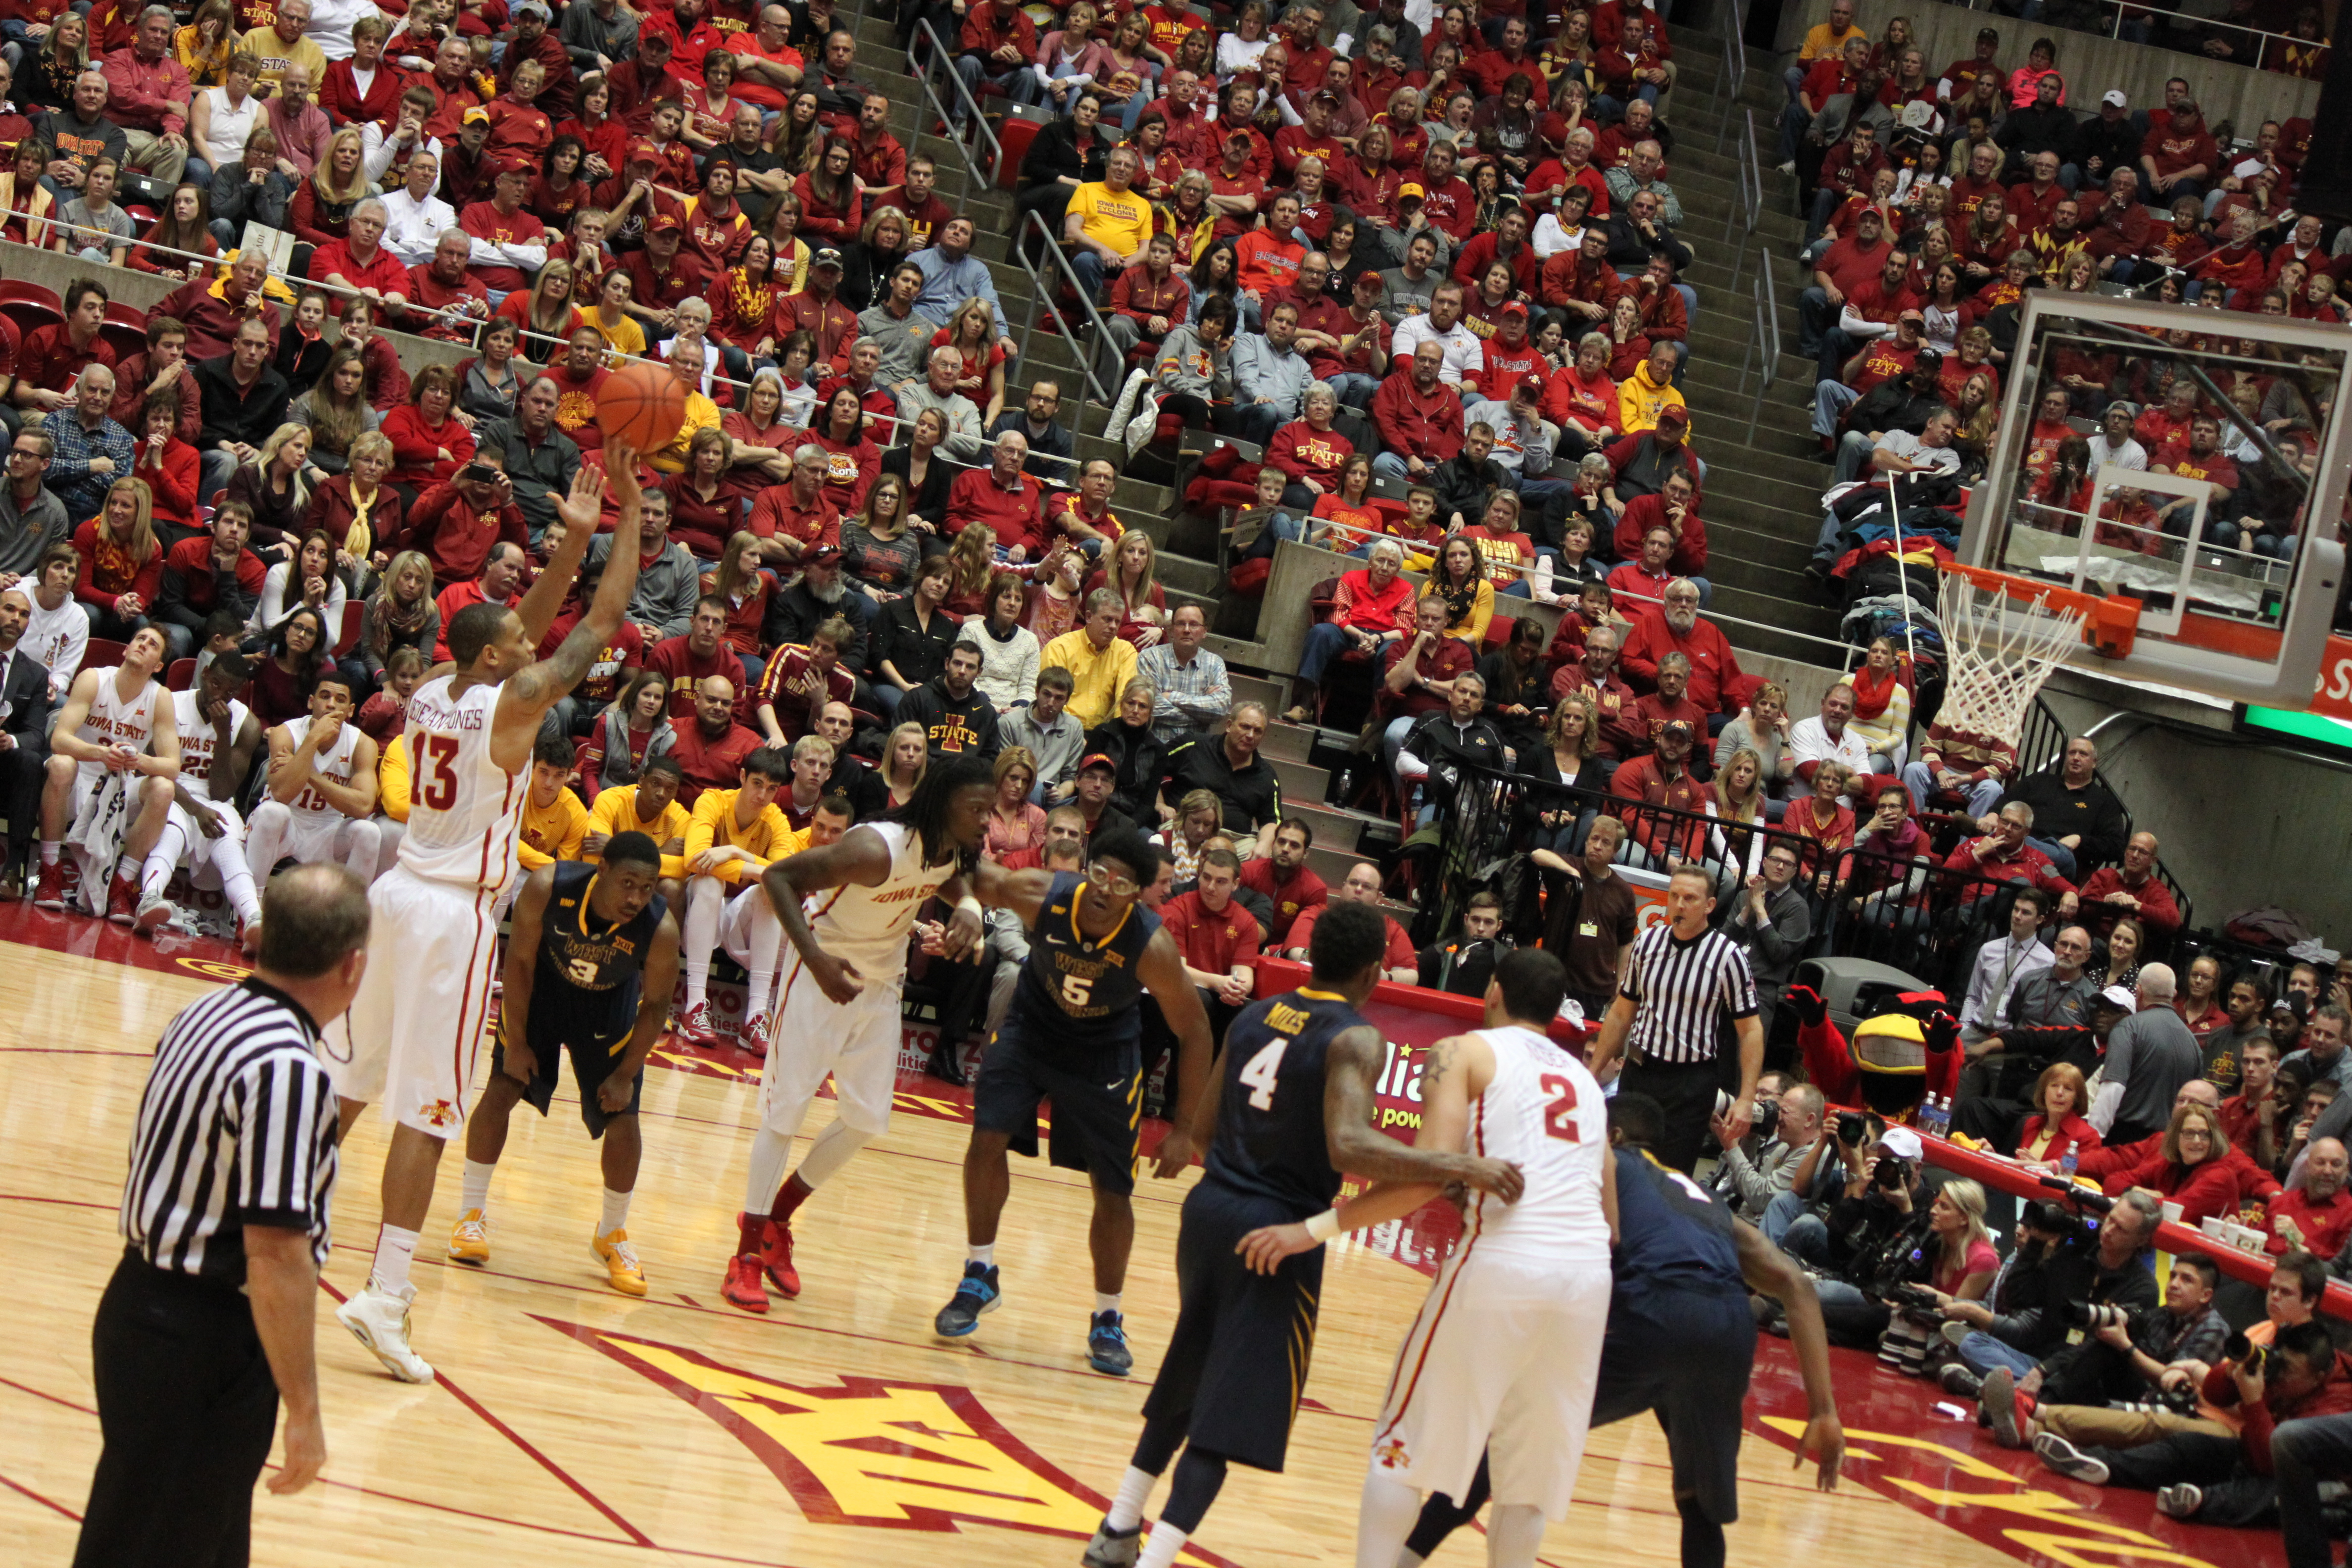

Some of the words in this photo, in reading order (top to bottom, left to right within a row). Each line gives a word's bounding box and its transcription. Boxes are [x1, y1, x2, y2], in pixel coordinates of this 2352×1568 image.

[57, 132, 78, 152] IOWA
[1097, 199, 1116, 208] IOWA
[1117, 203, 1137, 213] STATE
[1097, 205, 1138, 218] CYCLONES
[1865, 358, 1903, 374] STATE
[560, 391, 575, 403] IOWA
[1296, 444, 1344, 466] STATE
[479, 514, 497, 522] STATE
[784, 676, 807, 694] IOWA
[84, 714, 113, 733] IOWA
[114, 722, 147, 740] STATE
[928, 725, 979, 746] STATE
[408, 729, 459, 812] 13
[297, 788, 327, 812] 15
[870, 886, 917, 903] IOWA
[568, 958, 599, 983] 3
[1062, 974, 1094, 1007] 5
[1263, 1001, 1311, 1035] MILES
[1238, 1037, 1288, 1112] 4
[419, 1104, 458, 1126] STATE
[1539, 1072, 1581, 1144] 2
